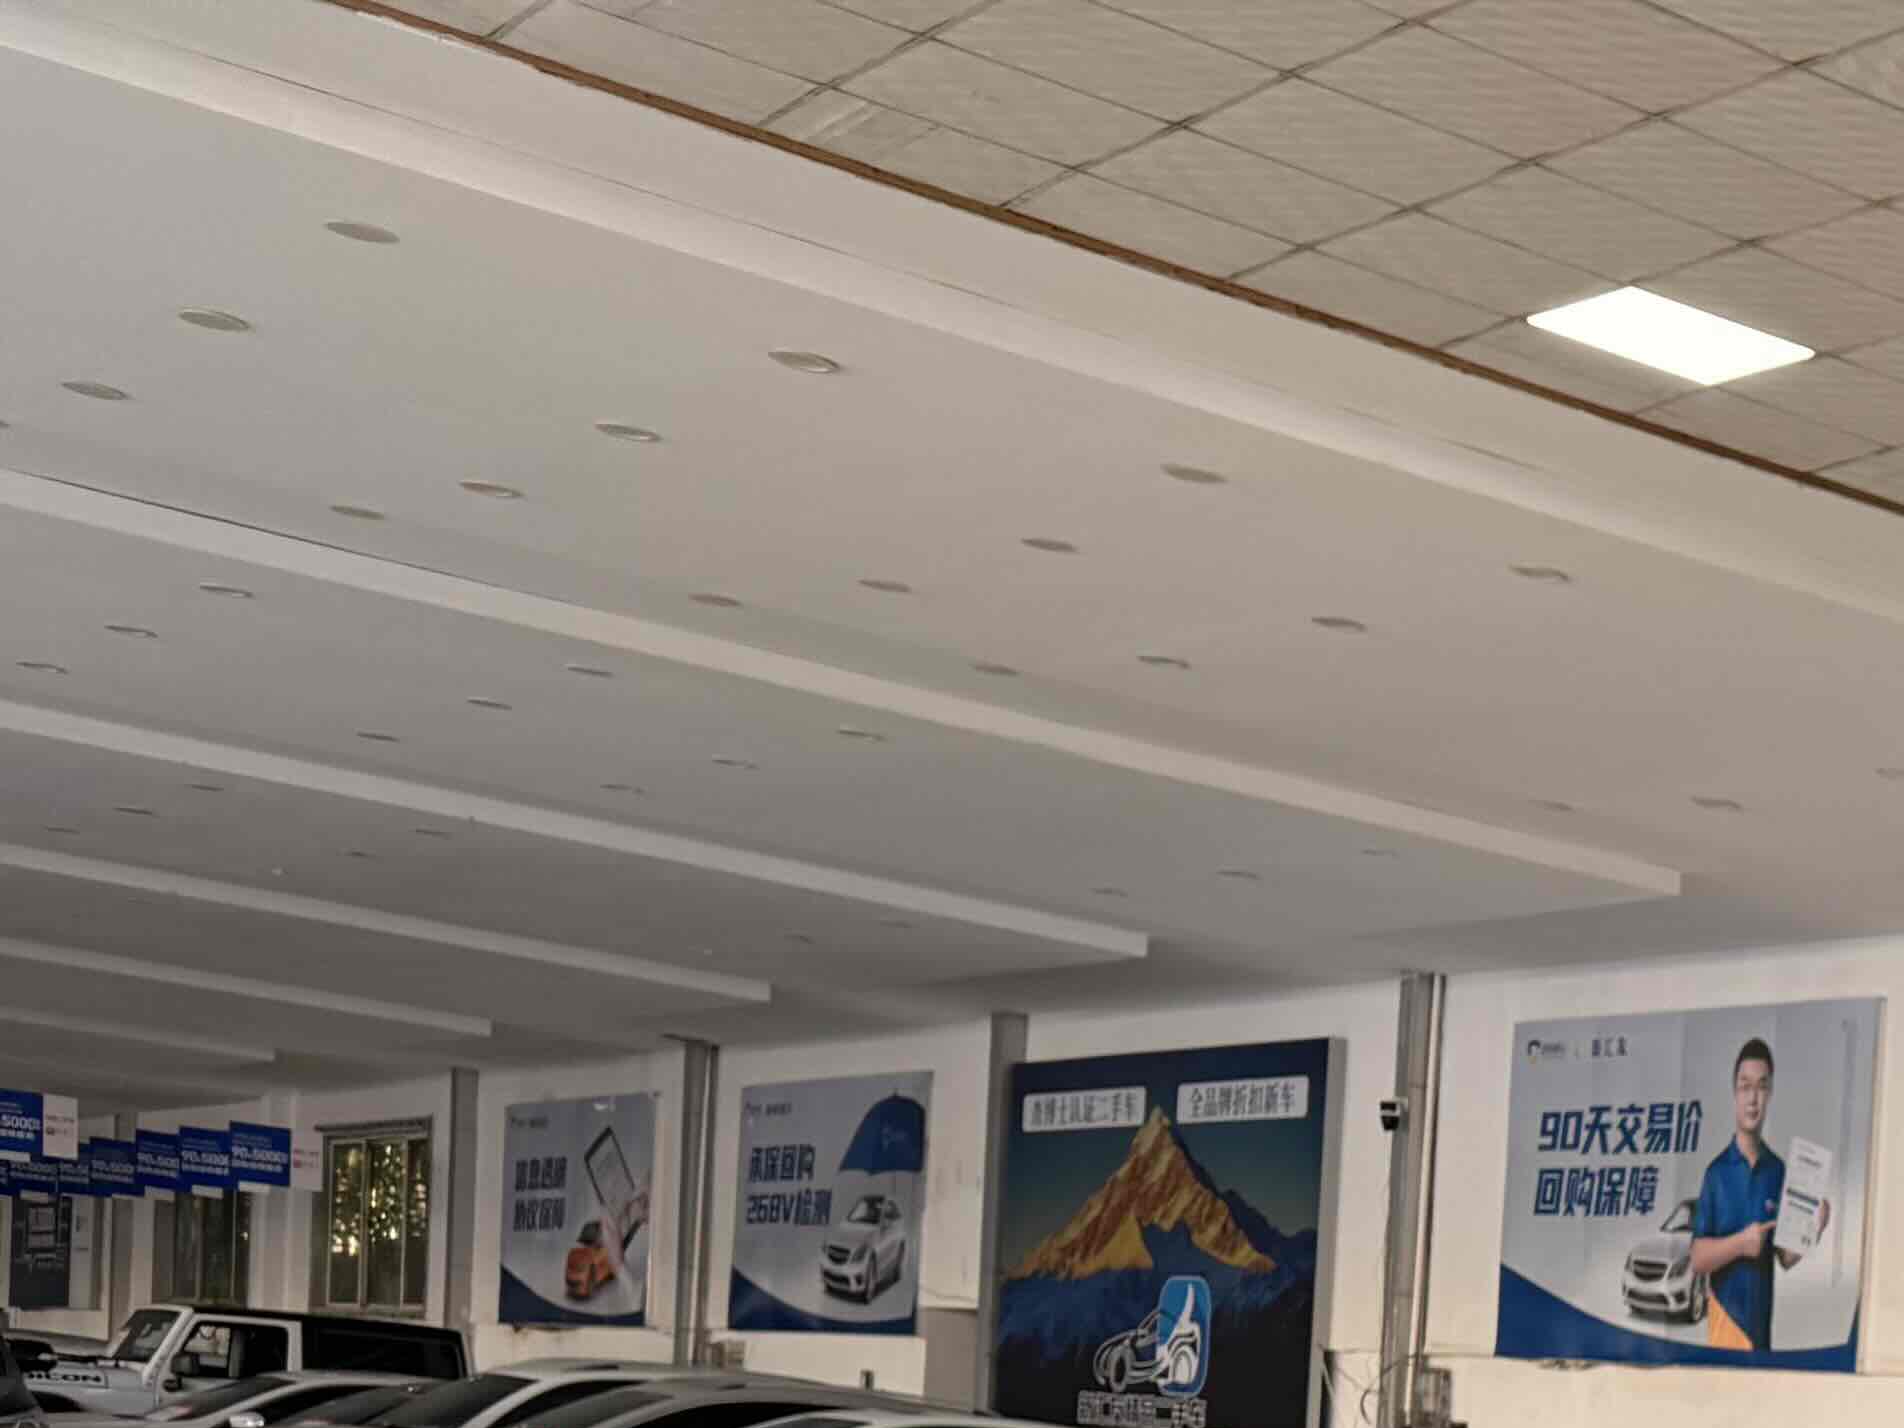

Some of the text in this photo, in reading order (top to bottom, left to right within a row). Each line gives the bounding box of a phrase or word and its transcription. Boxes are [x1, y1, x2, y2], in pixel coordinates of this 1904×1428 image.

[1536, 1099, 1704, 1155] 90天交易价
[1532, 1165, 1660, 1218] 回购保障
